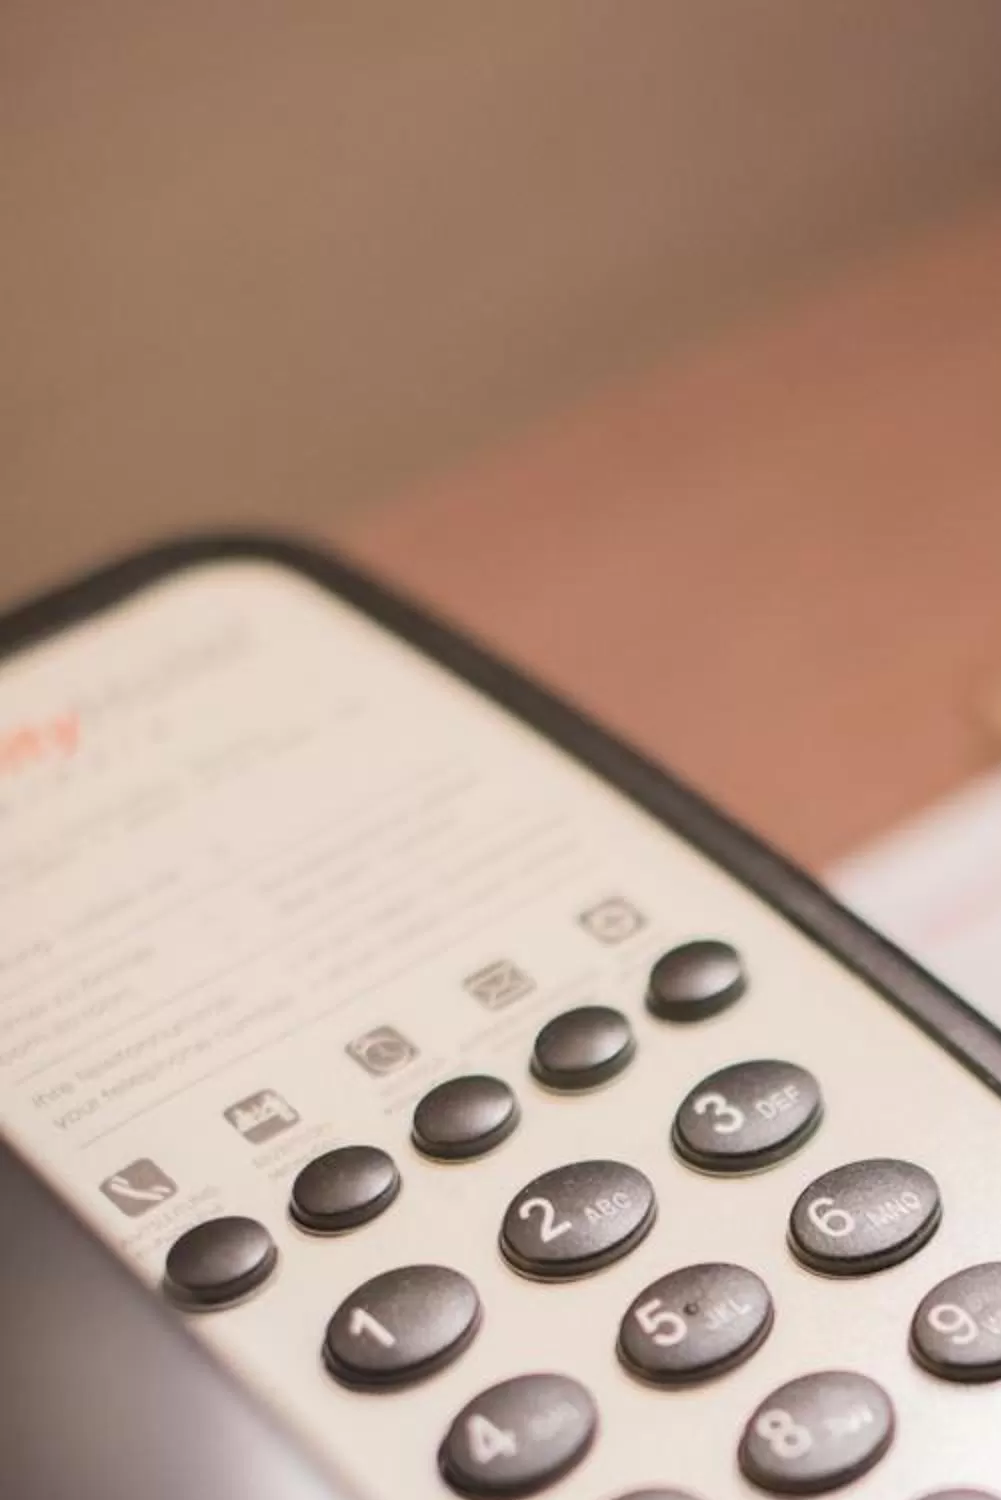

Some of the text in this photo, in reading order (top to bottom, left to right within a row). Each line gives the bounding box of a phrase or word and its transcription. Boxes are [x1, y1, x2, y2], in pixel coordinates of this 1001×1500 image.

[692, 1083, 803, 1134] 3 DEF
[518, 1190, 634, 1244] 2 ABC
[806, 1190, 923, 1238] 6 MNO
[348, 1306, 397, 1349] 1
[633, 1298, 688, 1347] 5
[927, 1302, 979, 1345] 9
[465, 1413, 517, 1465] 4
[755, 1407, 813, 1460] 8
